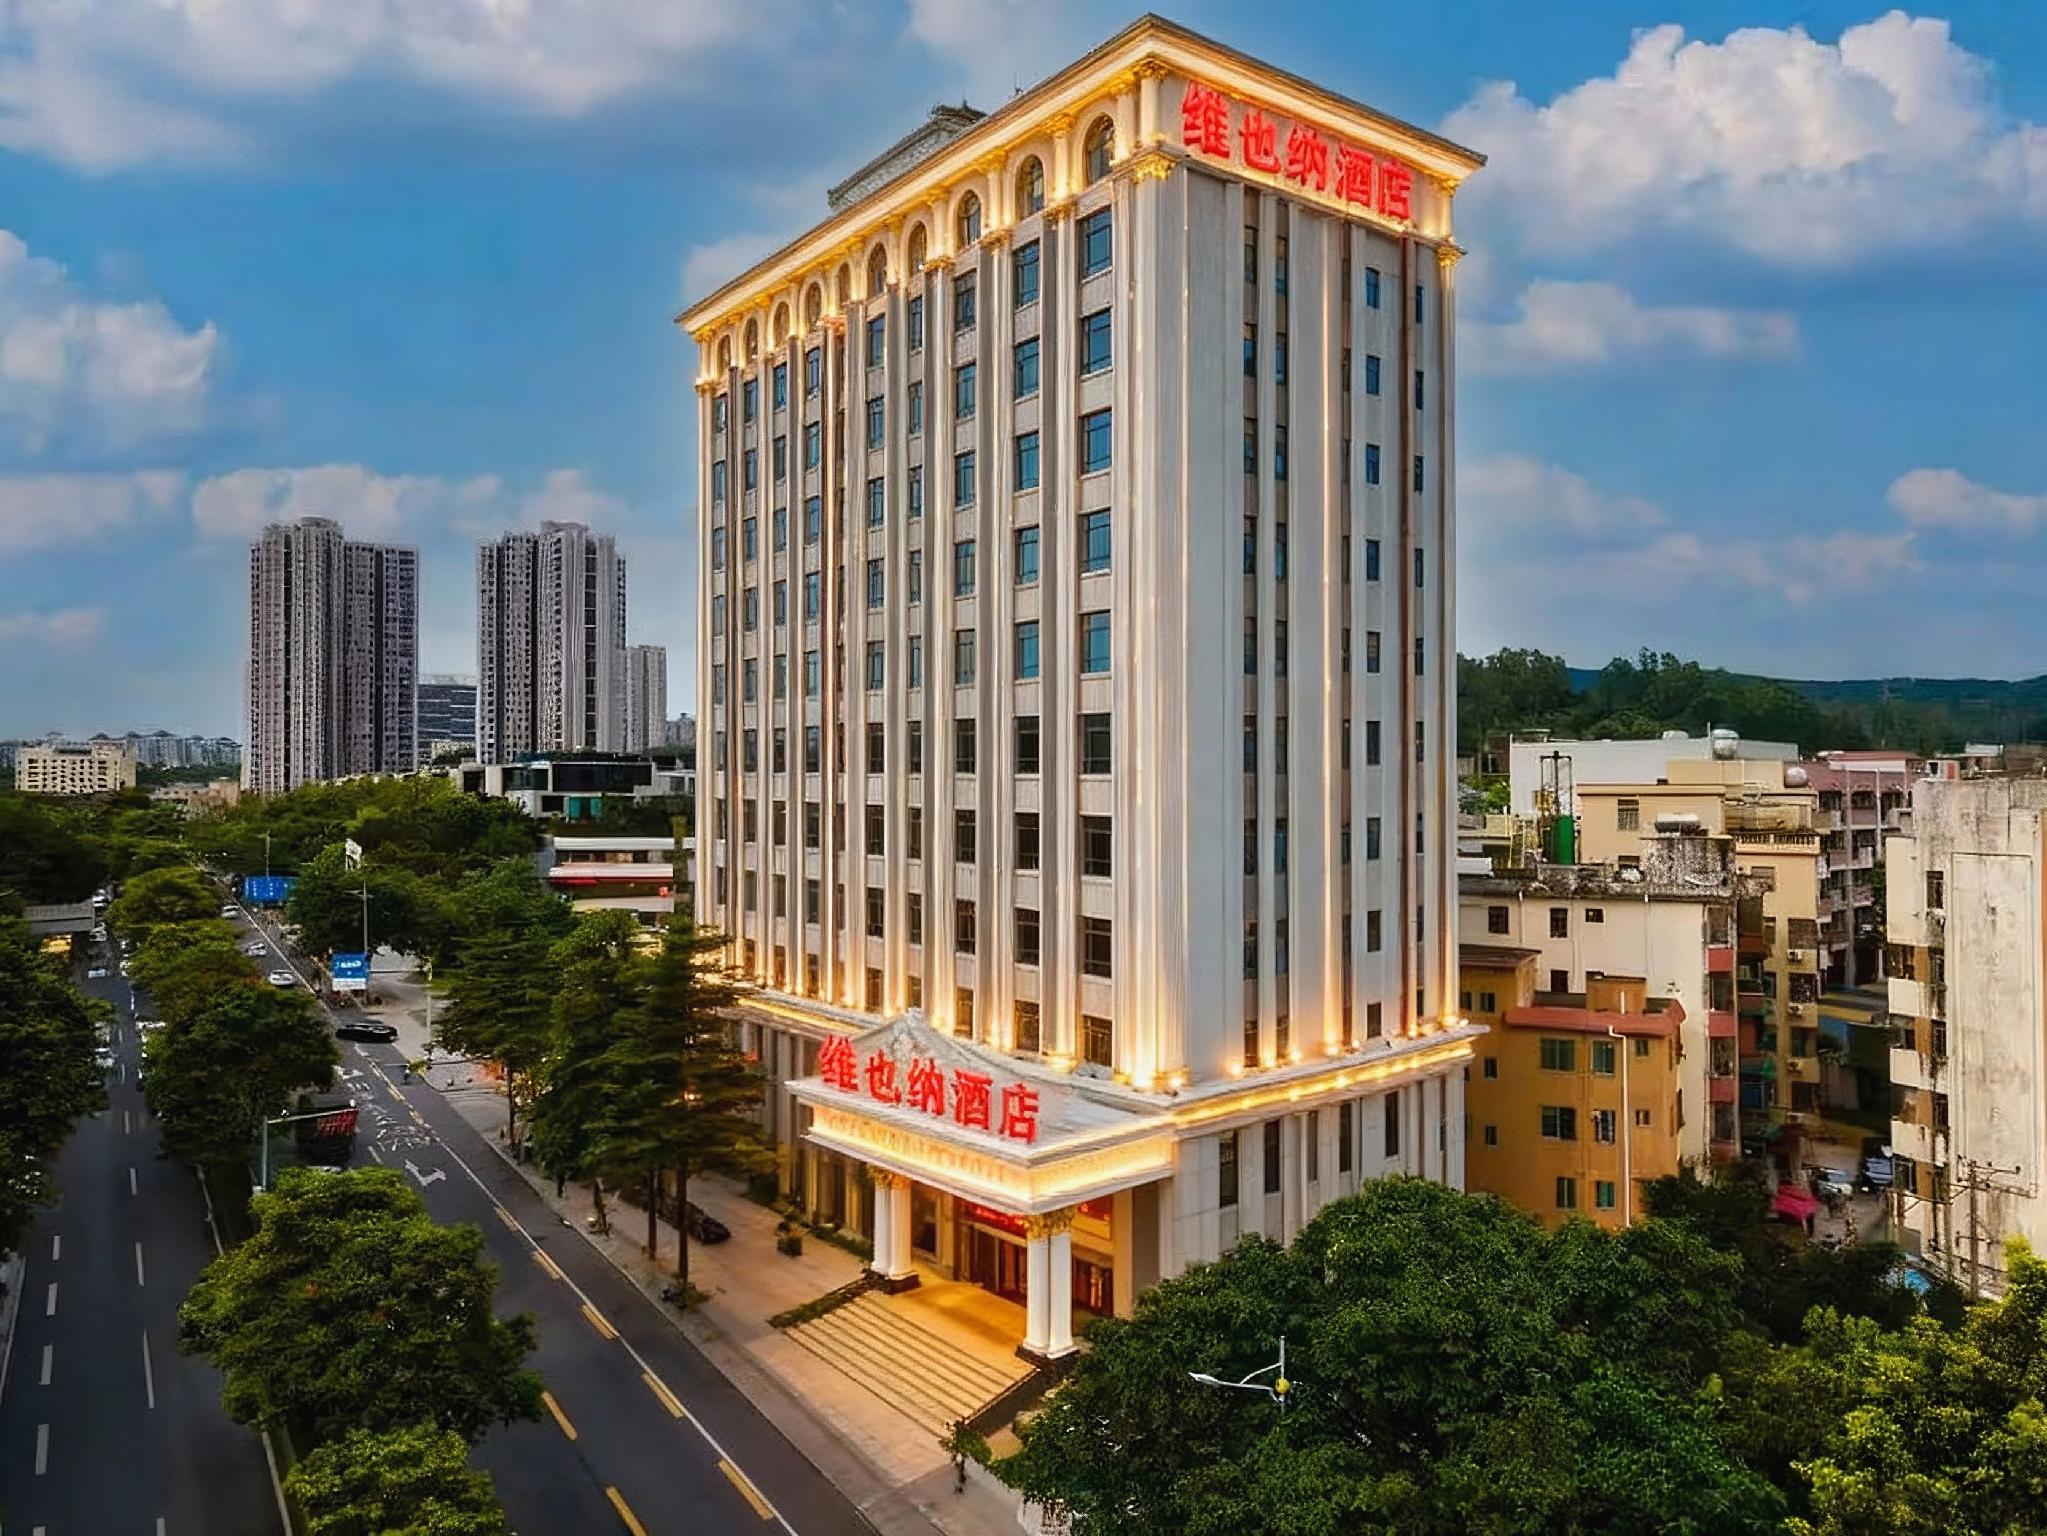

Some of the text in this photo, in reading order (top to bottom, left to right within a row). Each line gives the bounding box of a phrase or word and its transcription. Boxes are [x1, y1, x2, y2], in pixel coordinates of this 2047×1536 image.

[1181, 80, 1412, 220] 维也纳酒店
[818, 1034, 1039, 1143] 维也纳酒店
